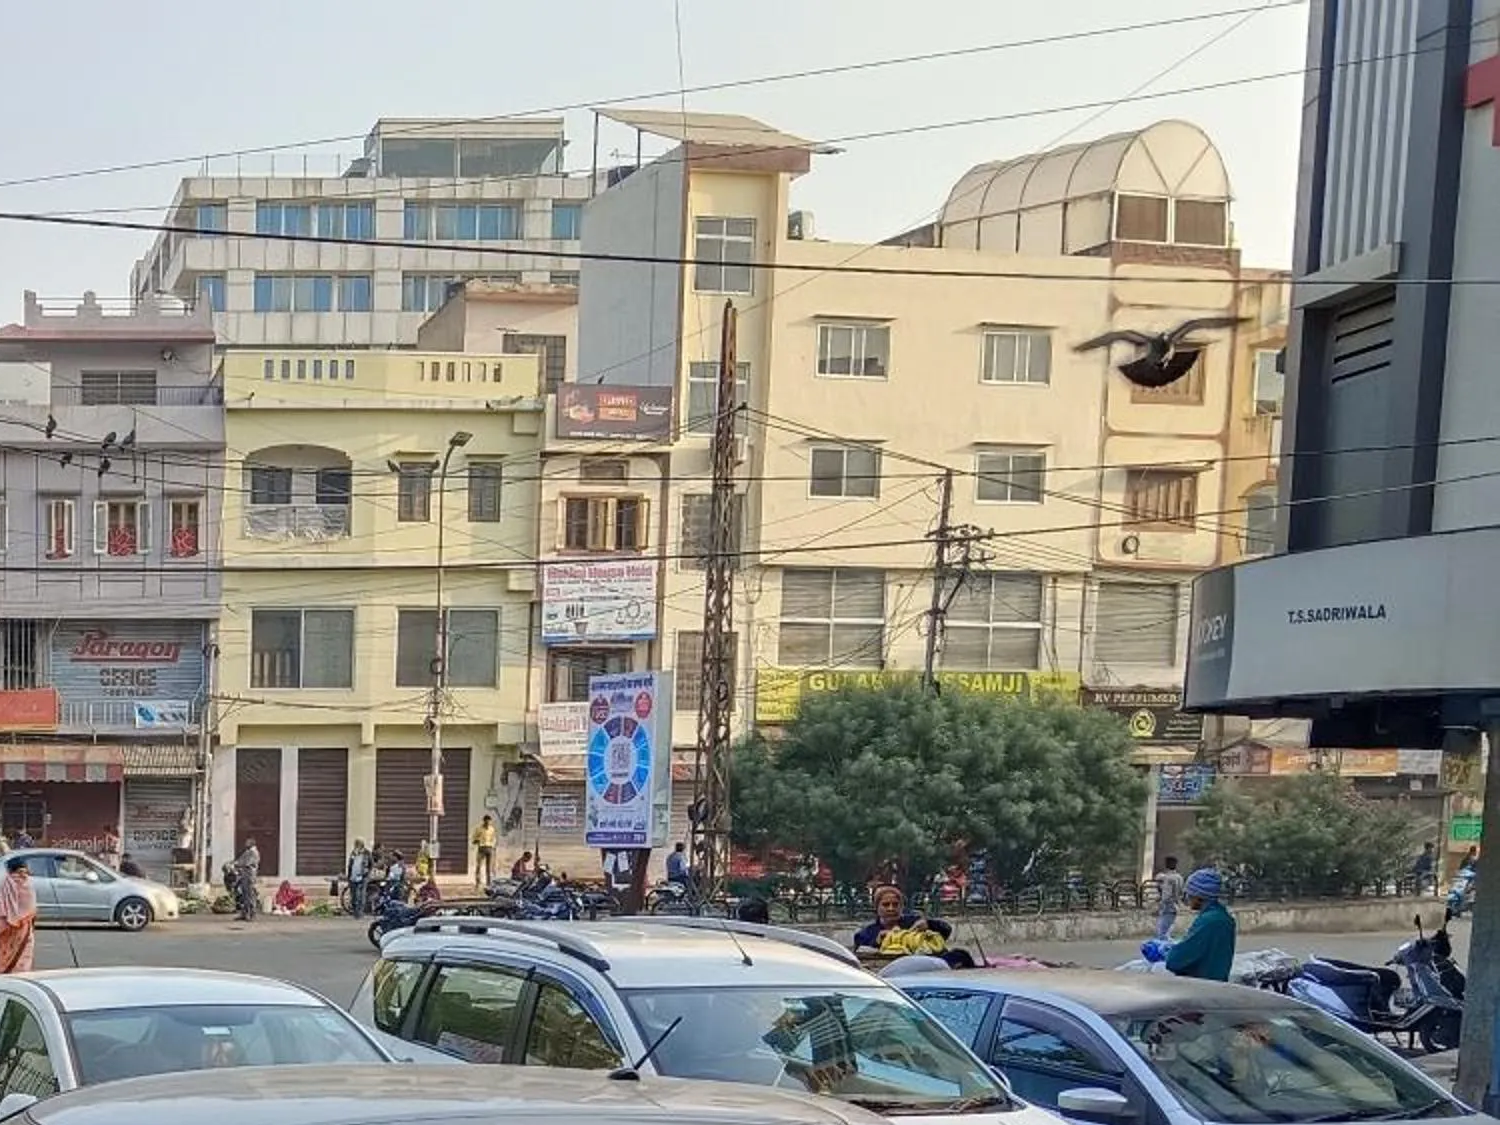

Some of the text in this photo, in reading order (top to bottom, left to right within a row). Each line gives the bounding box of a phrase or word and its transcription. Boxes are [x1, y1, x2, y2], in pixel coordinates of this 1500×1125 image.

[1287, 604, 1387, 624] T.S.SADRIWALA
[70, 630, 181, 663] Paragon
[100, 667, 157, 687] OFFICE
